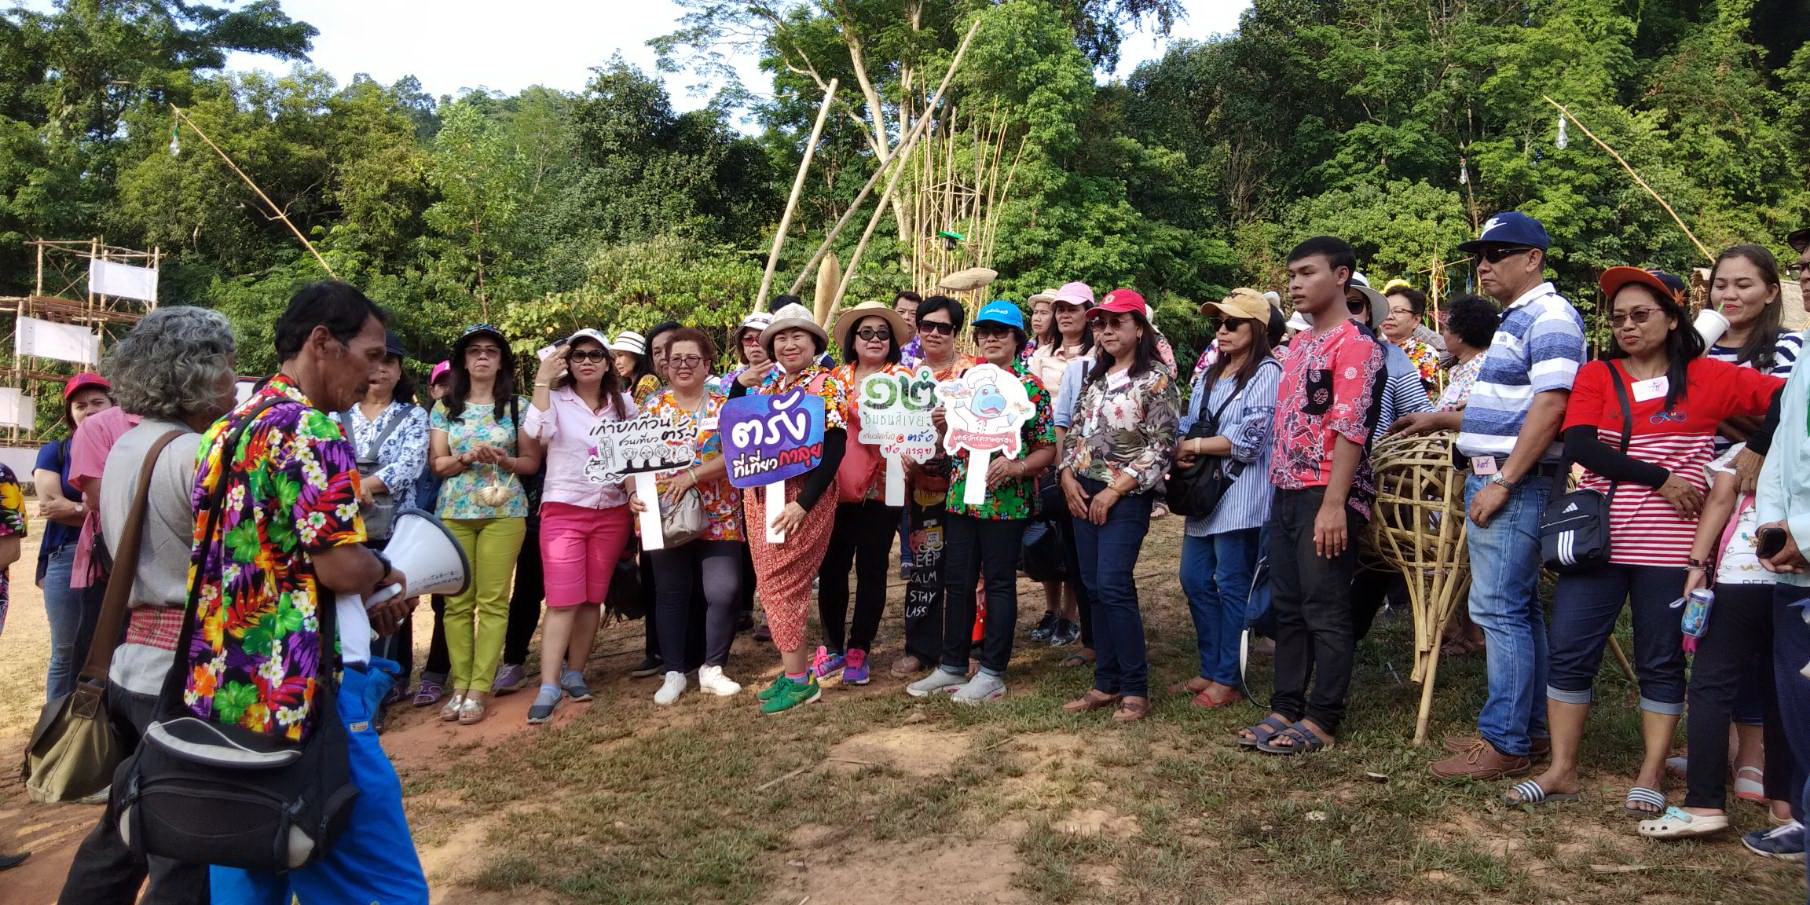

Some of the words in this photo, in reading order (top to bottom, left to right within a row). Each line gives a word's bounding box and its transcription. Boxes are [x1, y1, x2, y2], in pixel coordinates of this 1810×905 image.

[731, 390, 806, 448] ตรัง
[661, 419, 697, 440] ตรัง
[907, 428, 934, 442] ตรัง
[732, 449, 778, 479] ที่เที่ยว
[914, 552, 941, 568] EEP
[909, 589, 936, 604] STAY
